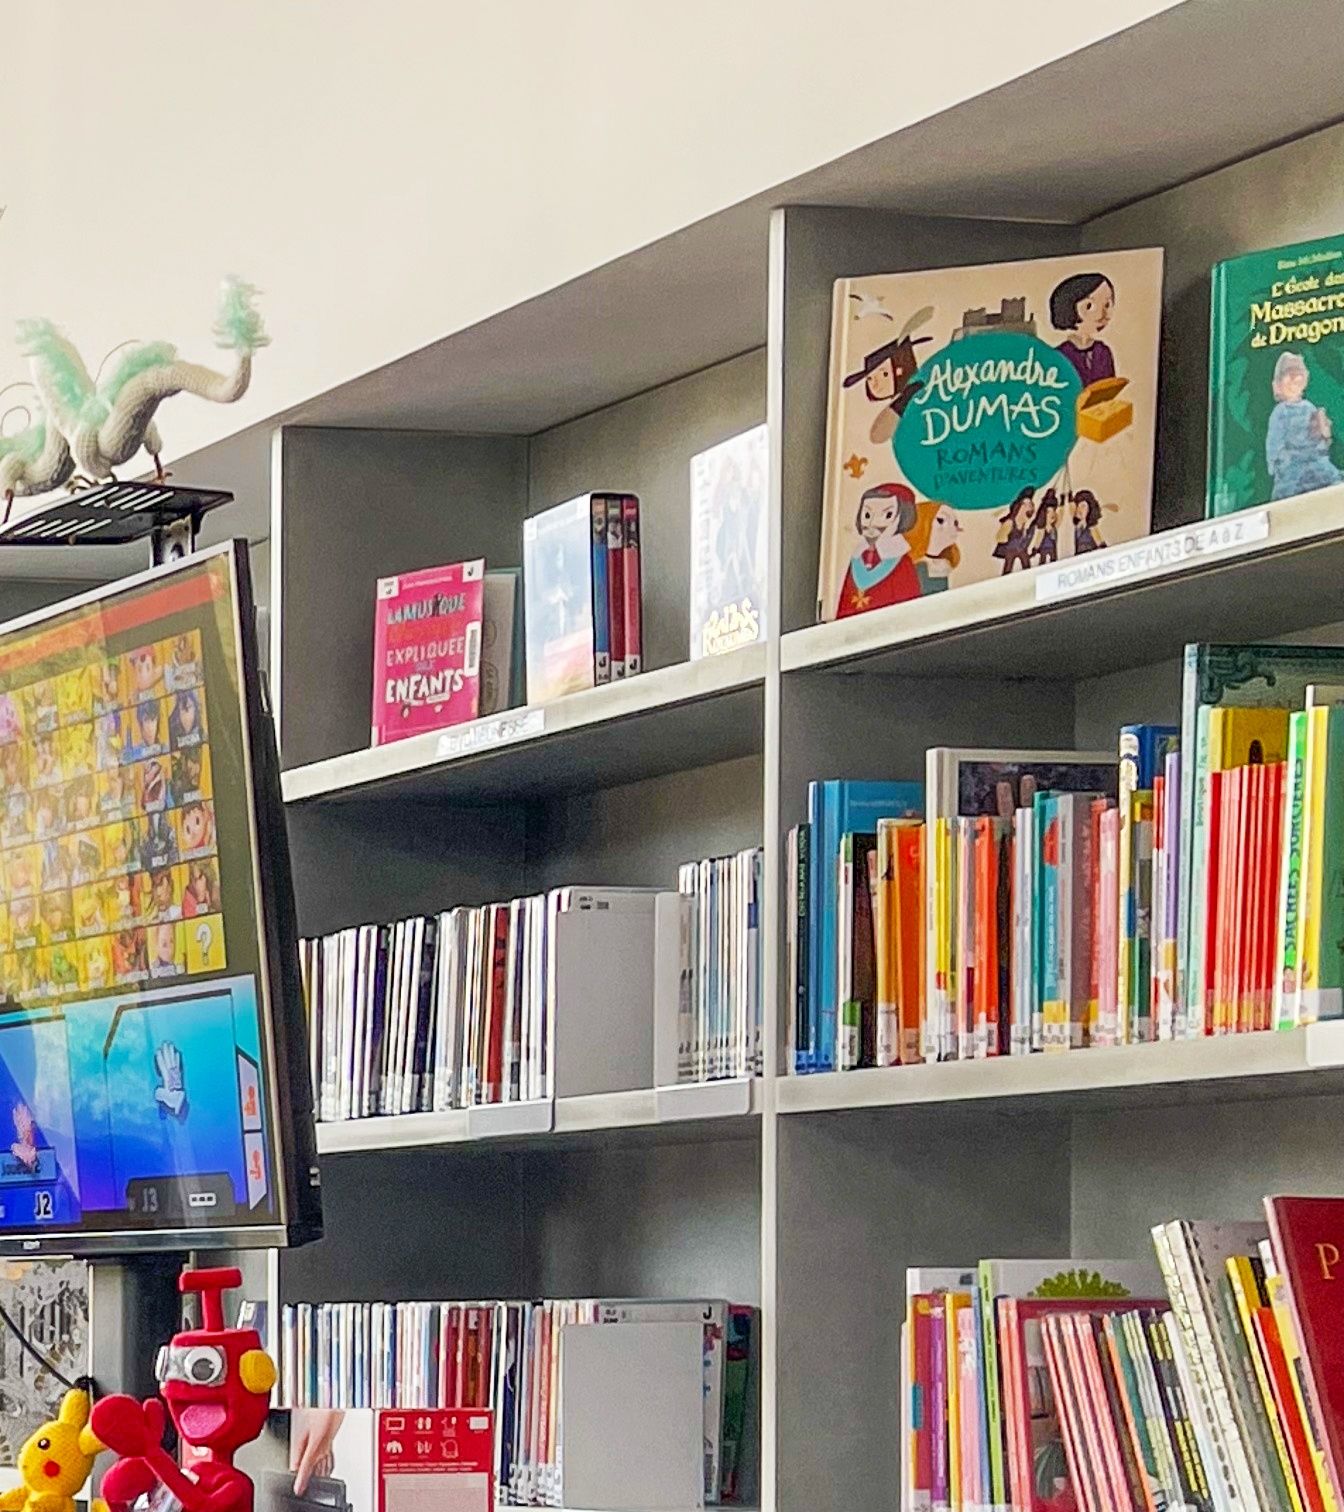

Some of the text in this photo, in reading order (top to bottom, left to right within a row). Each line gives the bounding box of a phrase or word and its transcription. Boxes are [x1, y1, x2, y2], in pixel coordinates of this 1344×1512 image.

[914, 346, 1069, 405] Alexandre
[920, 391, 1061, 445] DUMAS
[936, 440, 1038, 469] ROMANS
[1057, 558, 1115, 589] ROMANS
[1184, 532, 1207, 556] DE
[1234, 522, 1245, 541] Z
[385, 668, 464, 705] ENFANTS
[34, 1191, 53, 1219] J2
[1314, 1242, 1340, 1280] P
